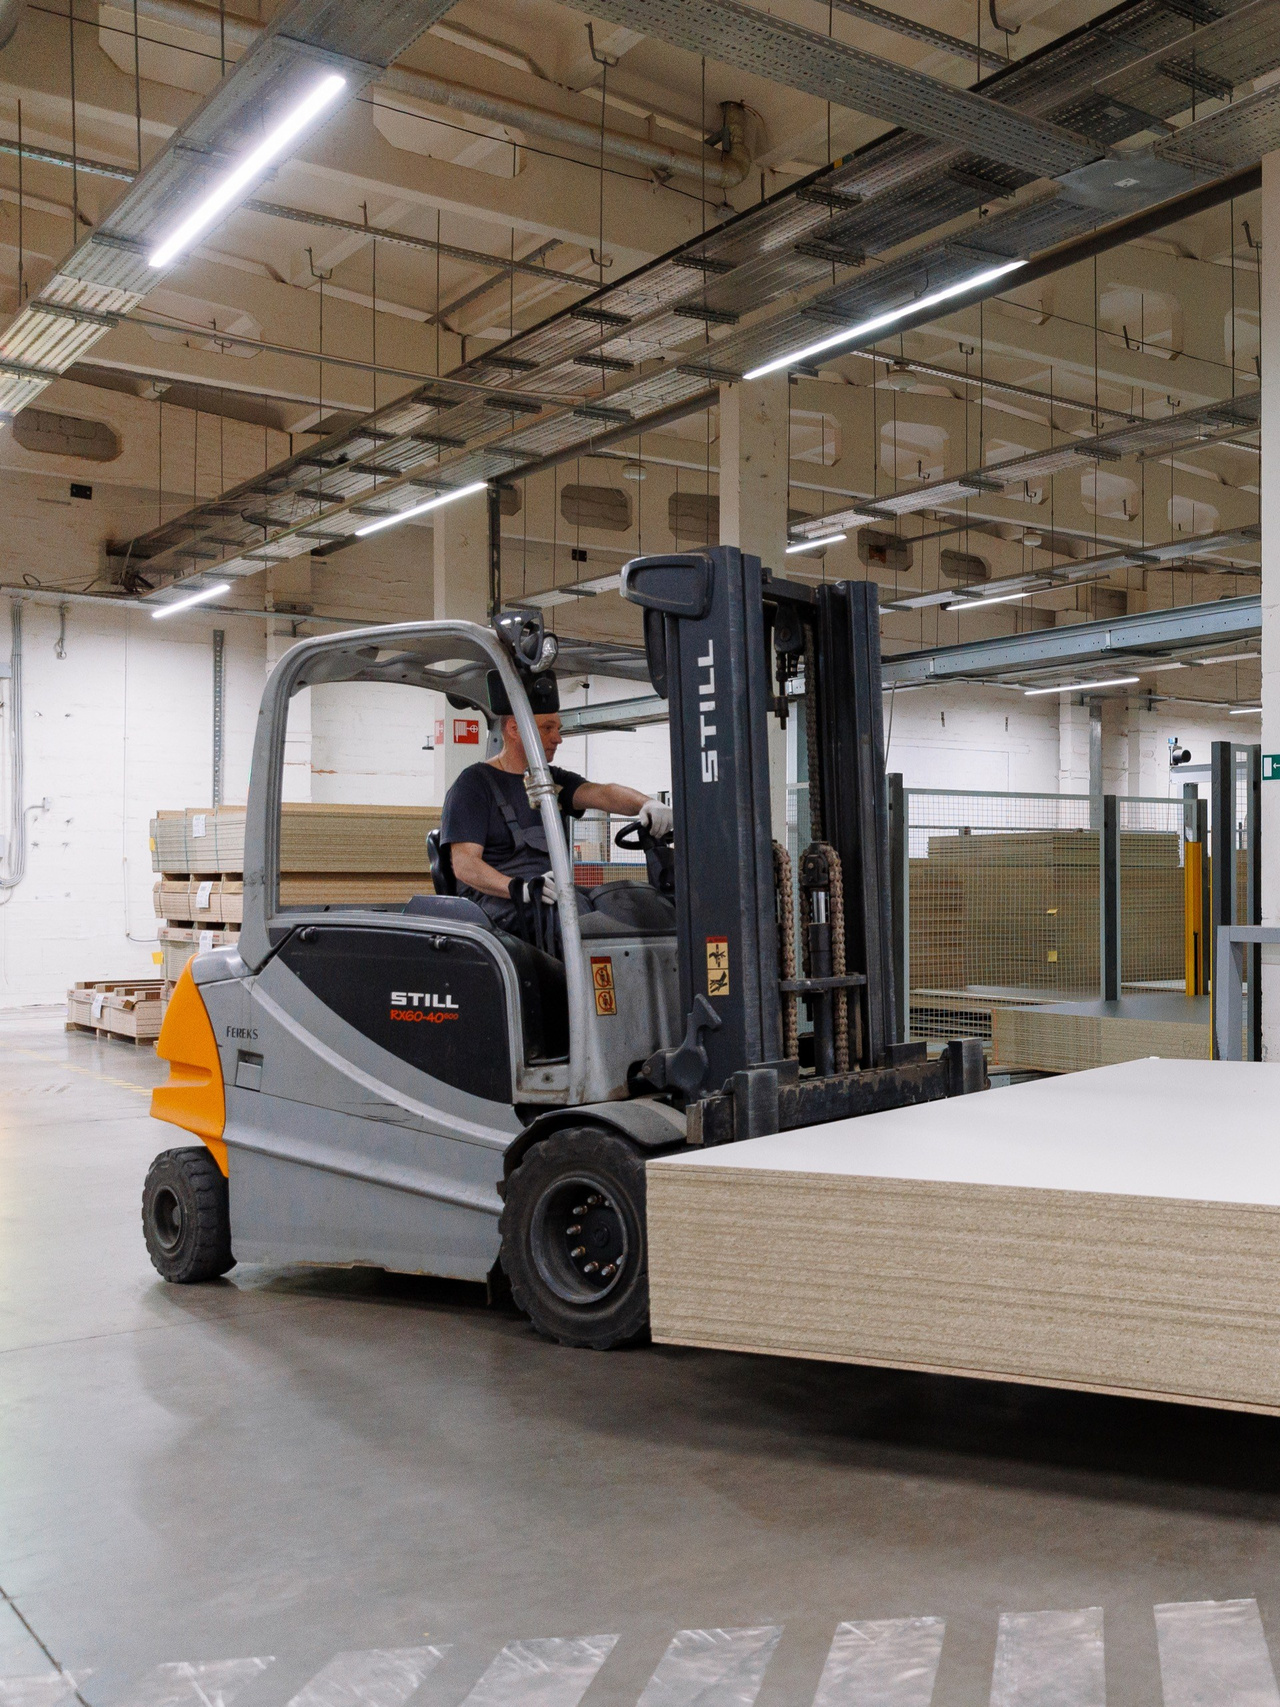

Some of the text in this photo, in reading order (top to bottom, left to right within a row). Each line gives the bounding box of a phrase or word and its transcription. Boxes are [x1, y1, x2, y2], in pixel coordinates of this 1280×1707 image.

[698, 639, 718, 783] STILL
[391, 991, 459, 1009] STILL
[226, 1025, 259, 1040] FEREKS
